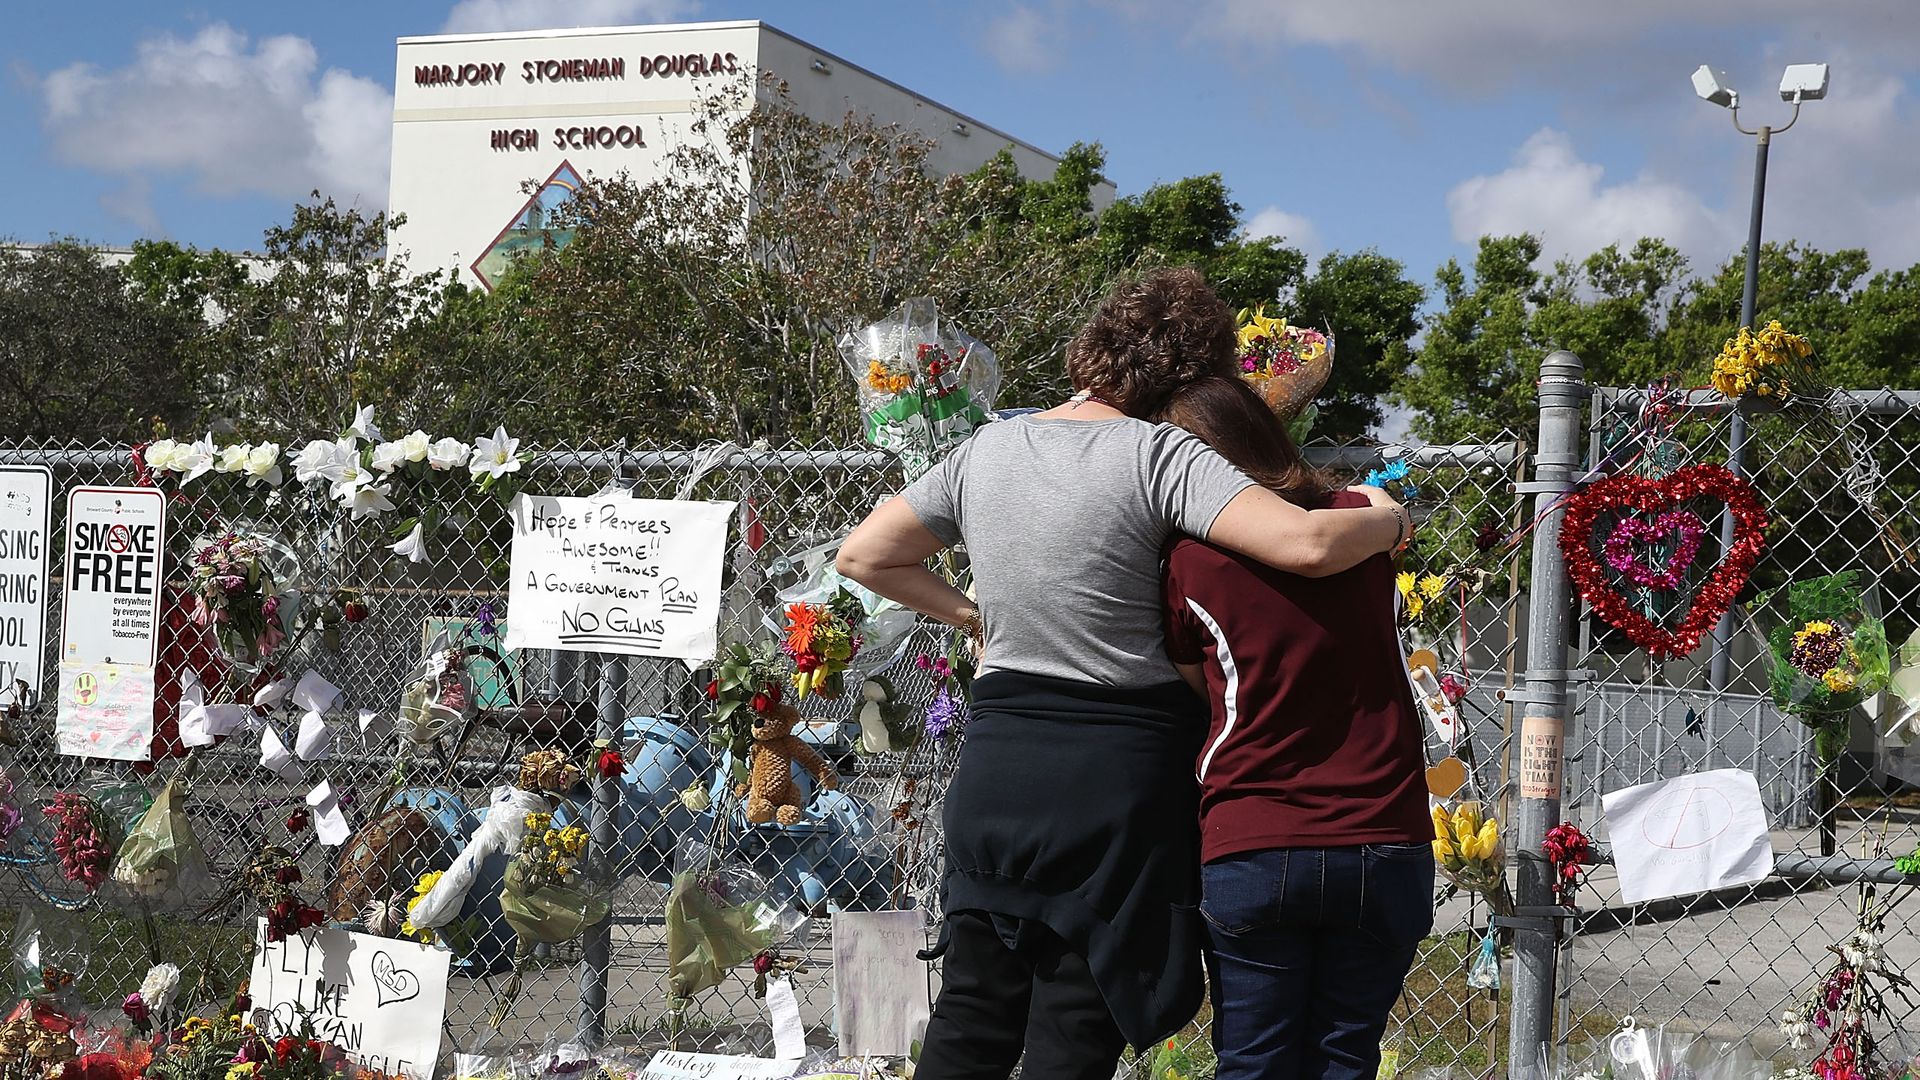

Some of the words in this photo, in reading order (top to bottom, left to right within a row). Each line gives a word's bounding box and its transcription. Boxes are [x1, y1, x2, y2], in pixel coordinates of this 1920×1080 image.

[414, 62, 504, 86] MARJORY
[522, 57, 624, 81] STONEMAN
[640, 52, 738, 78] DOUGLAS
[491, 128, 538, 151] HIGH
[554, 125, 646, 148] SCHOOL
[74, 522, 155, 553] SMOKE
[72, 552, 153, 594] FREE
[528, 571, 537, 590] A
[113, 597, 151, 606] everywhere
[113, 607, 121, 616] by
[122, 608, 151, 618] everyone
[112, 619, 119, 627] at
[121, 619, 130, 627] all
[131, 619, 150, 629] times
[112, 630, 149, 640] Tobacco-Free
[1527, 735, 1557, 746] NOW
[263, 923, 318, 976] FLY
[376, 959, 407, 992] MSD
[328, 1020, 363, 1050] AN
